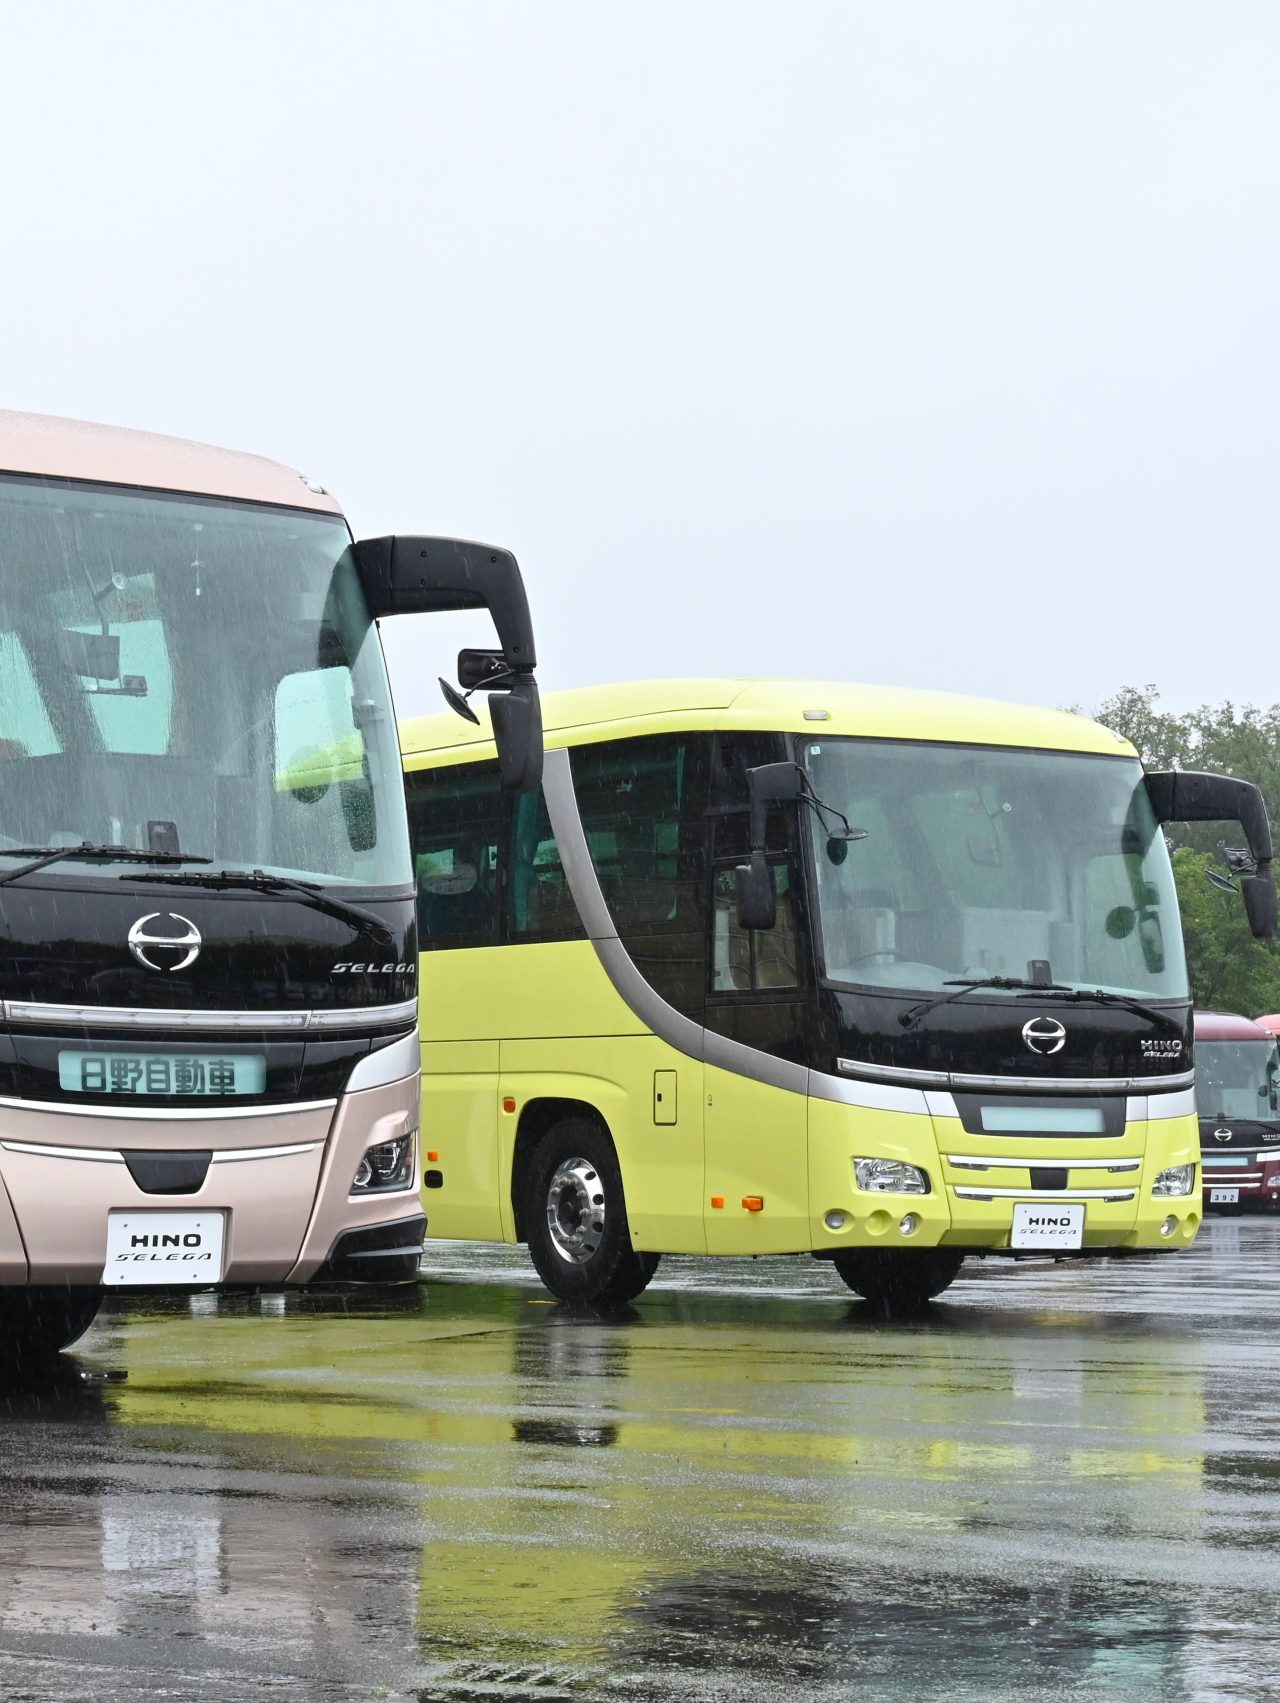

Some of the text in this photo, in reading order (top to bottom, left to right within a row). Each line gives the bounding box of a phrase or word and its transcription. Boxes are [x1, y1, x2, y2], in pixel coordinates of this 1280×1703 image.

[330, 962, 415, 973] SELEGA
[1141, 1040, 1182, 1050] HINO
[81, 1057, 235, 1095] 日野自動車
[1029, 1218, 1071, 1226] HINO
[131, 1234, 201, 1248] HINO
[115, 1253, 211, 1261] SELEGA
